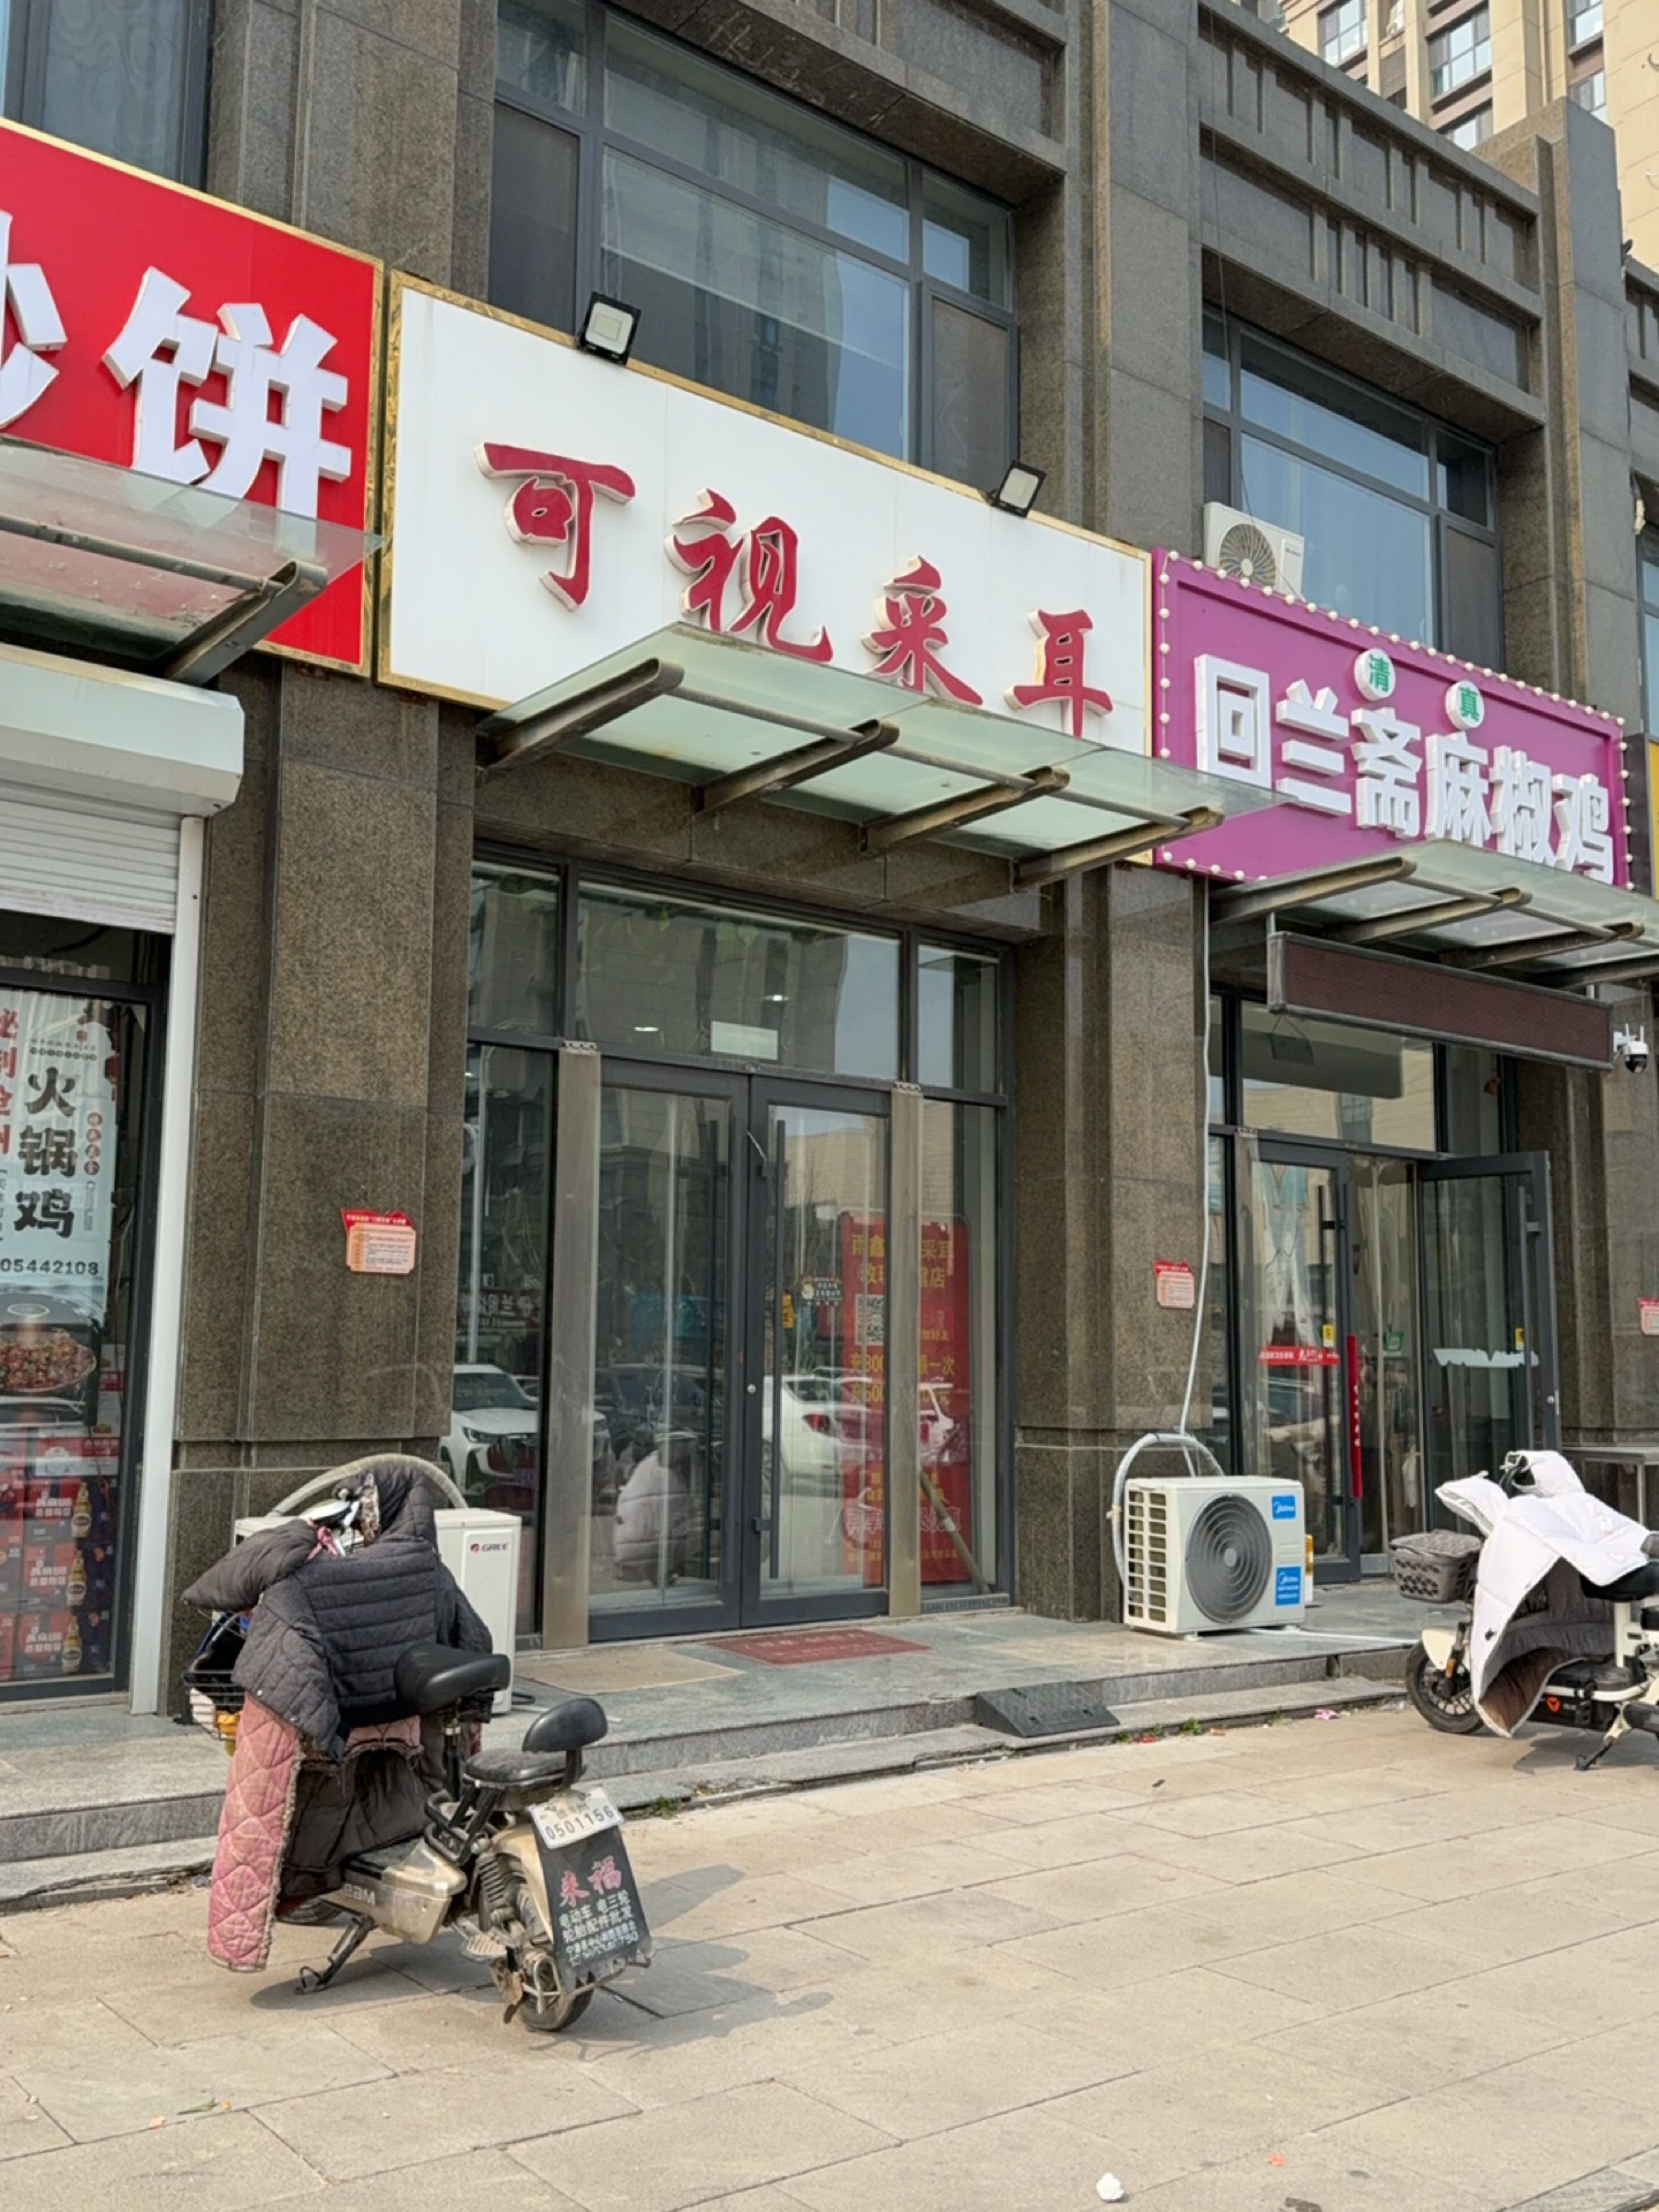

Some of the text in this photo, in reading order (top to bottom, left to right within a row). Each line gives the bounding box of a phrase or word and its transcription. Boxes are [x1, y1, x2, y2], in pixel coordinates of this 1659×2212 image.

[0, 211, 352, 556] 饼
[475, 442, 1113, 738] 可视采耳
[1368, 653, 1480, 722] 清真
[1194, 653, 1614, 884] 回兰斋麻椒鸡
[14, 1067, 77, 1238] 火锅鸡
